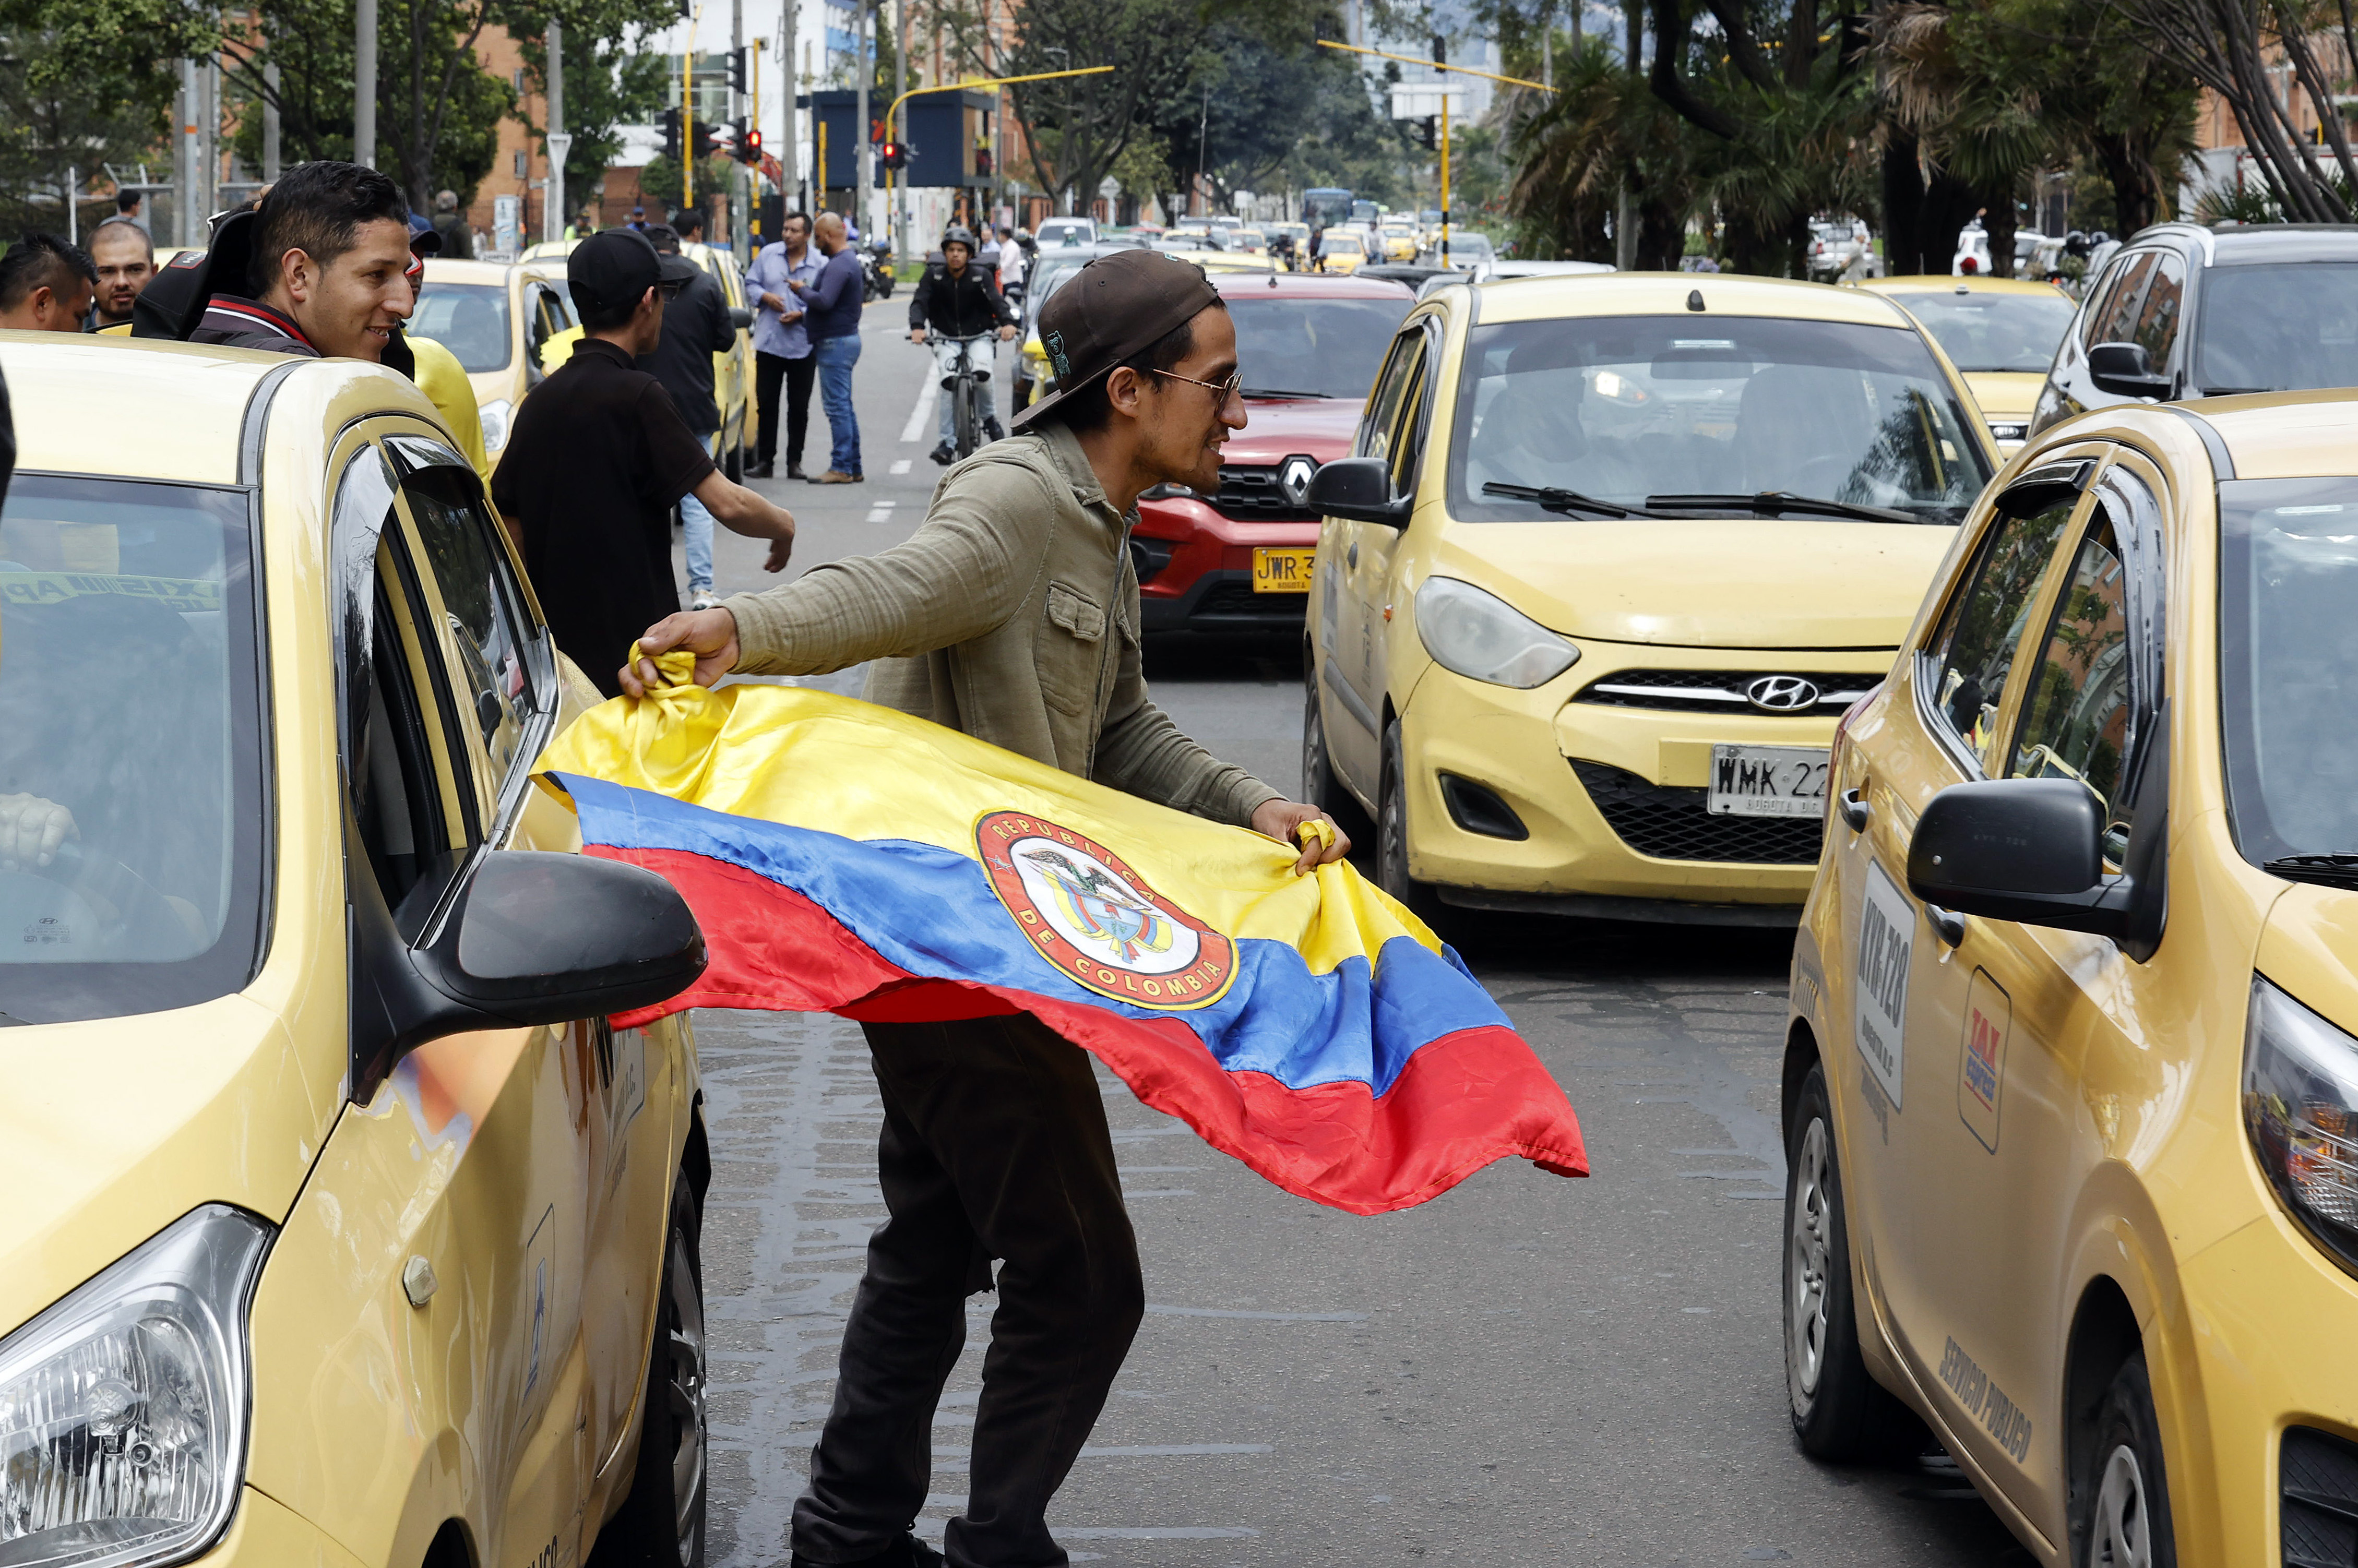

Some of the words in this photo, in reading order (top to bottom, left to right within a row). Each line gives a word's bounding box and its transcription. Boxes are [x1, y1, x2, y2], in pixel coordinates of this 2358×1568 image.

[1257, 556, 1297, 579] JWR
[1718, 758, 1781, 795] WMK
[992, 818, 1156, 902] REPUBLICA
[1018, 908, 1055, 945] DE
[1075, 961, 1222, 997] COLOMBIA
[1939, 1335, 1987, 1416] SERVICIO
